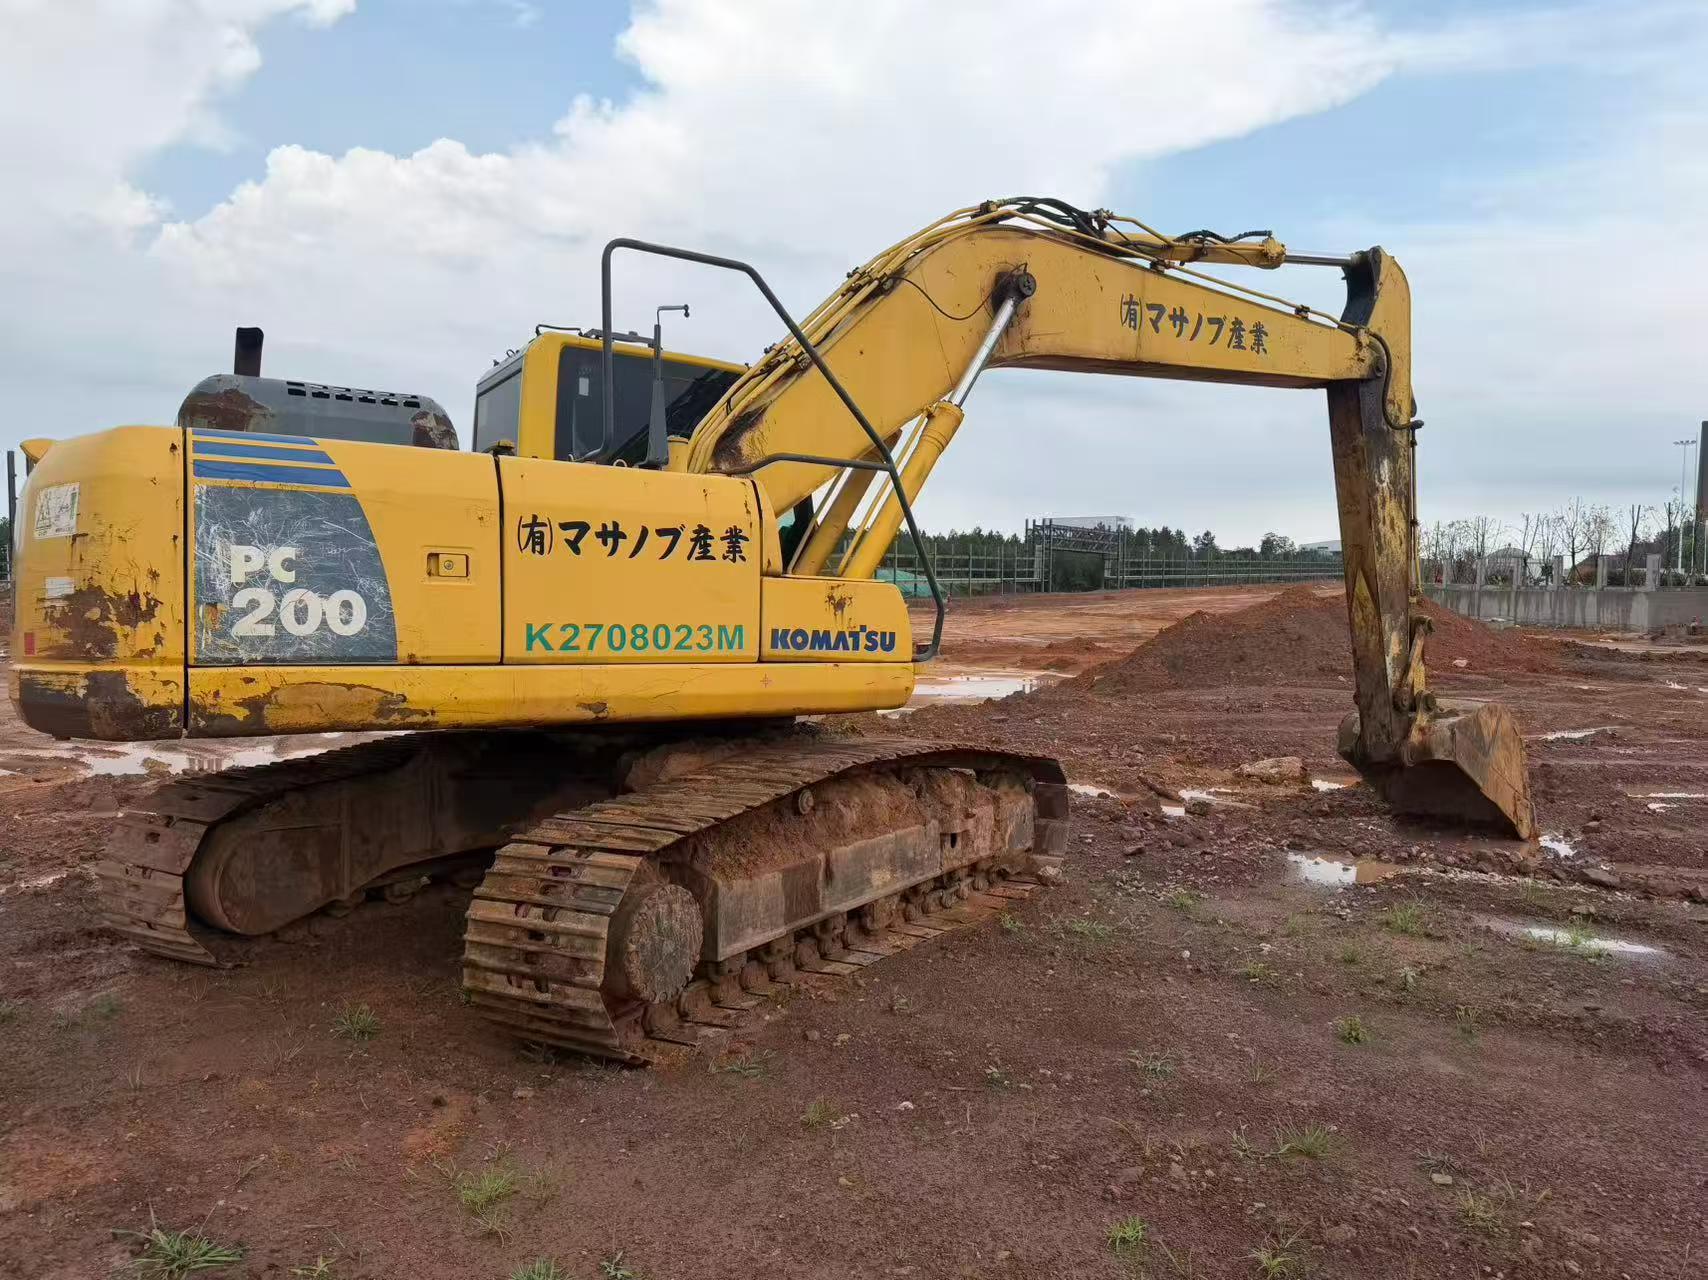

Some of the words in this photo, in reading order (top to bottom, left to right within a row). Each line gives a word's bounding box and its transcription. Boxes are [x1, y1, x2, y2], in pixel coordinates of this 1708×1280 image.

[229, 545, 297, 583] PC
[230, 588, 368, 637] 200
[525, 622, 744, 652] K2708023M
[770, 624, 896, 653] KOMATSU
